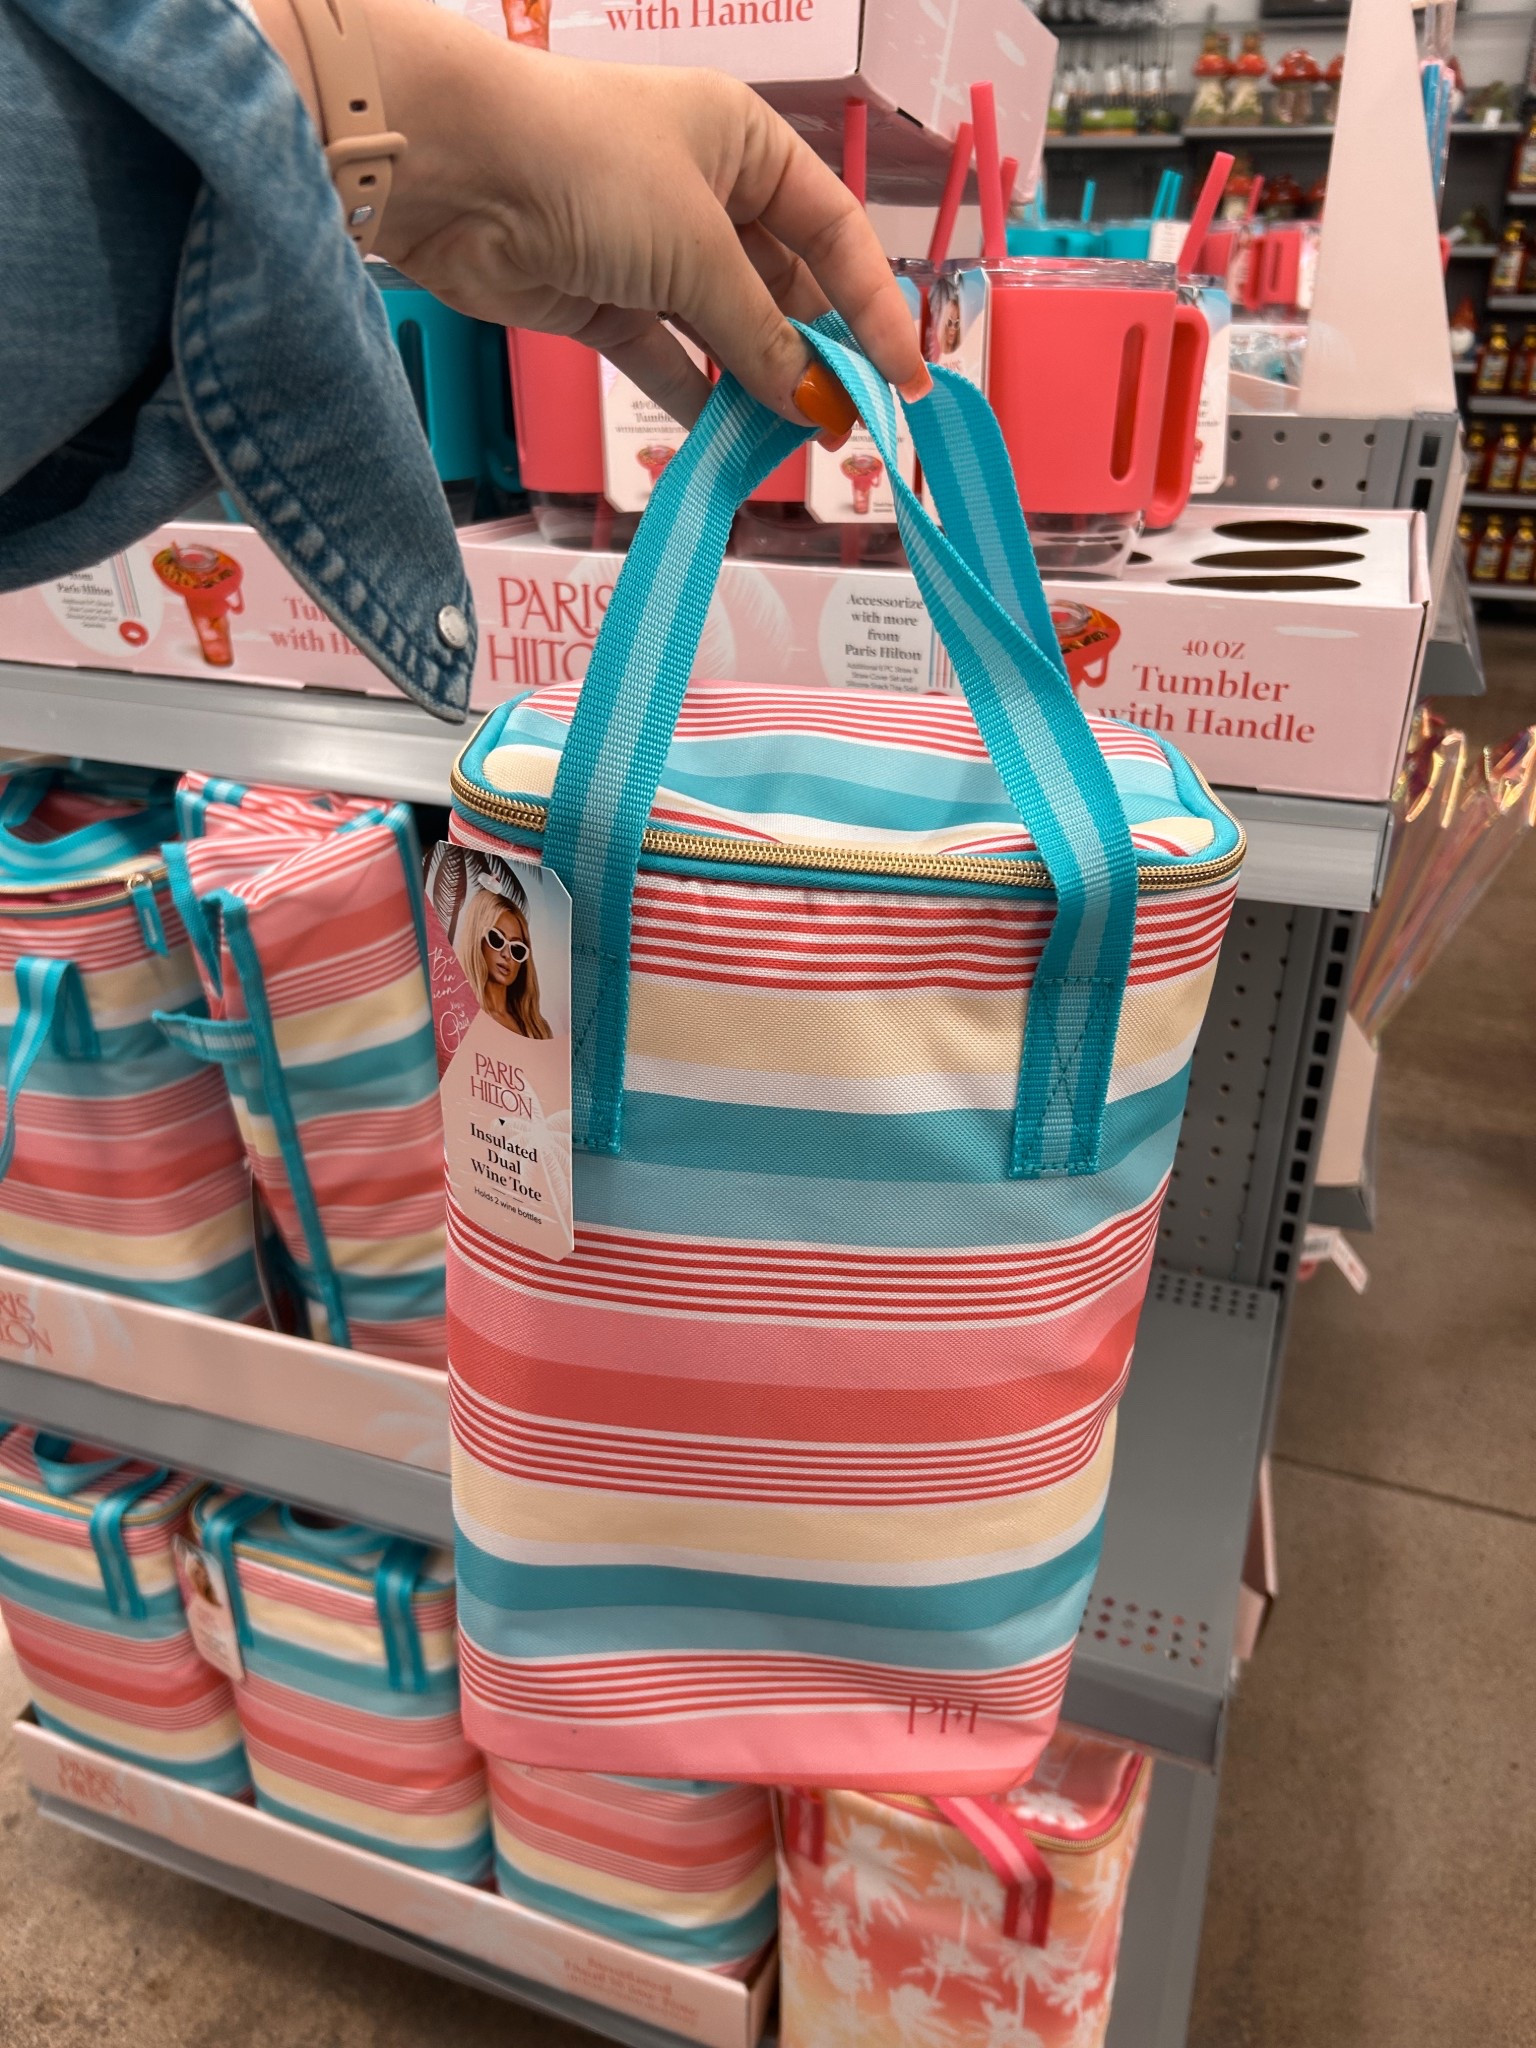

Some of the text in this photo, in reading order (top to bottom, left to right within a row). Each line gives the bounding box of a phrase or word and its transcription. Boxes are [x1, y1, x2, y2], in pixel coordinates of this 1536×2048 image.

[606, 0, 814, 31] with Handle
[846, 594, 924, 610] Accessorize
[851, 611, 919, 626] with more
[845, 644, 922, 661] Paris Hilton
[867, 628, 900, 642] from
[1182, 639, 1246, 660] 40 OZ
[487, 635, 595, 686] HILTO
[1132, 664, 1289, 702] Tumbler
[1098, 702, 1315, 743] with Handle
[475, 1053, 525, 1091] PARIS
[471, 1075, 532, 1120] HILTON
[470, 1122, 538, 1163] Insulated
[487, 1148, 521, 1175] Dual
[470, 1157, 542, 1202] Wine Tote
[474, 1186, 542, 1225] Holds 2 wine bottles
